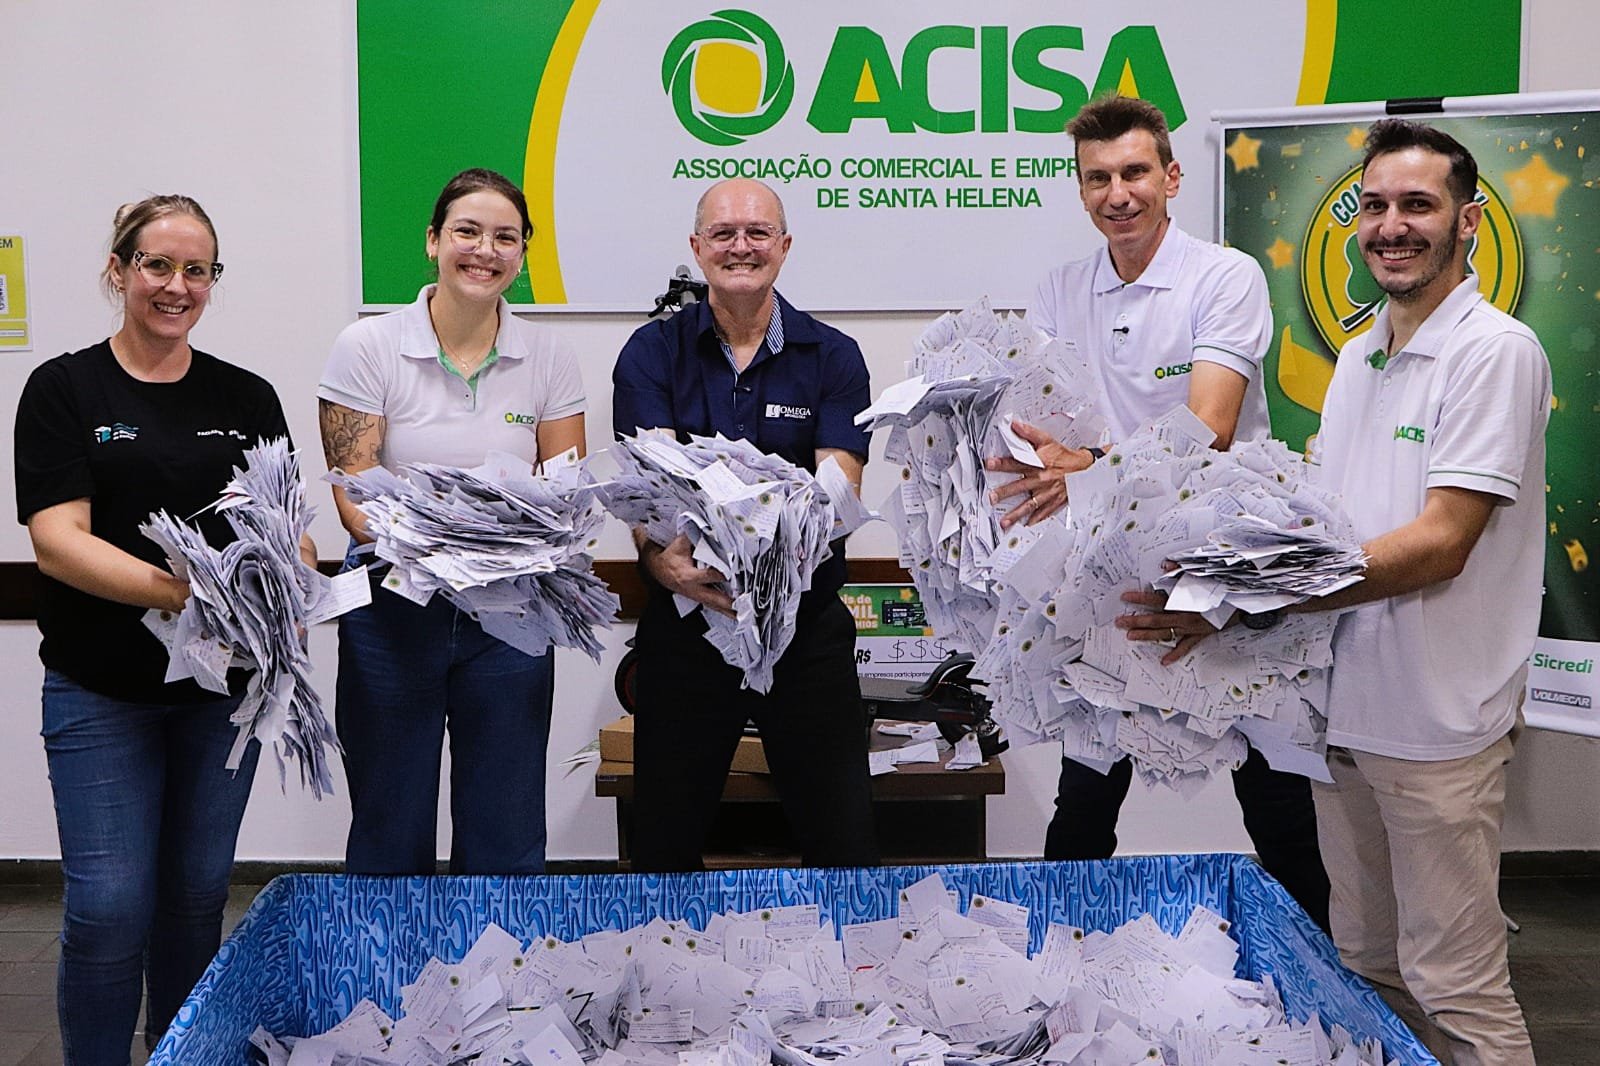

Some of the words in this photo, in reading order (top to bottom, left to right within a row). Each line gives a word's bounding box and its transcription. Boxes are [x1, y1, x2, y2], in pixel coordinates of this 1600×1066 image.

[807, 25, 1188, 134] ACISA
[673, 154, 832, 184] ASSOCIAÇÃO
[841, 158, 981, 178] COMERCIAL
[991, 159, 1006, 178] E
[817, 188, 849, 208] DE
[858, 188, 937, 208] SANTA
[945, 188, 1042, 208] HELENA
[780, 406, 811, 416] OMEGA
[1533, 653, 1593, 673] Sicredi
